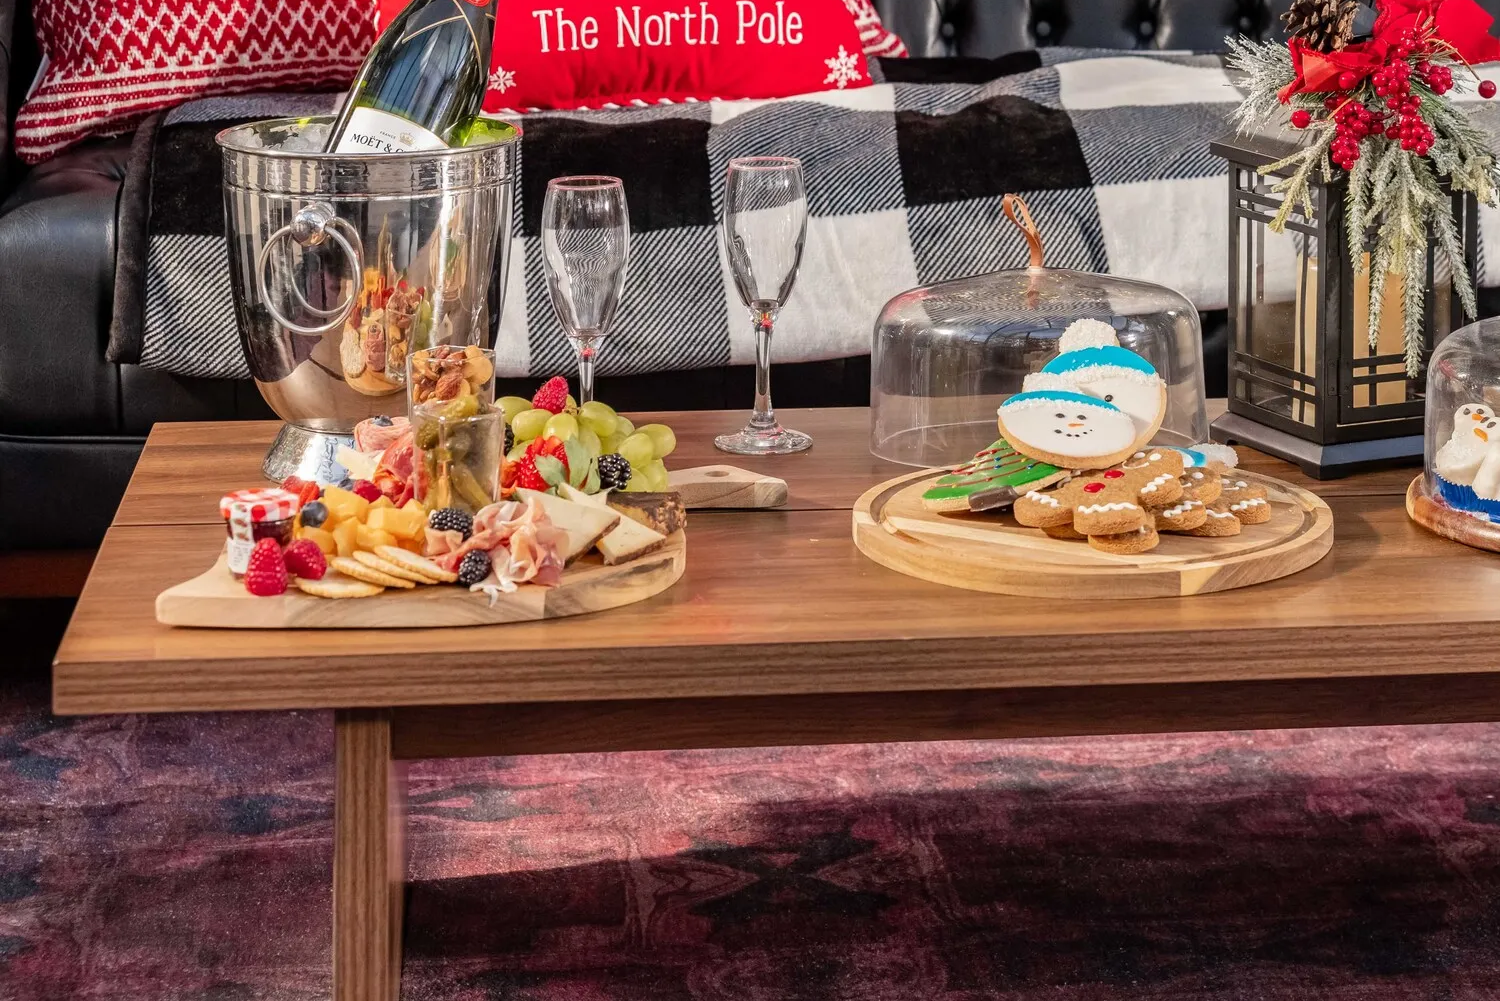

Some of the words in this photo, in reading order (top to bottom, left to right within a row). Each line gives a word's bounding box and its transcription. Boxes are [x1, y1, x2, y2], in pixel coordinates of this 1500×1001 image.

[531, 7, 600, 53] The
[615, 0, 719, 49] North
[735, 0, 804, 47] Pole
[350, 133, 384, 149] MOËT
[379, 130, 397, 141] FRANCE
